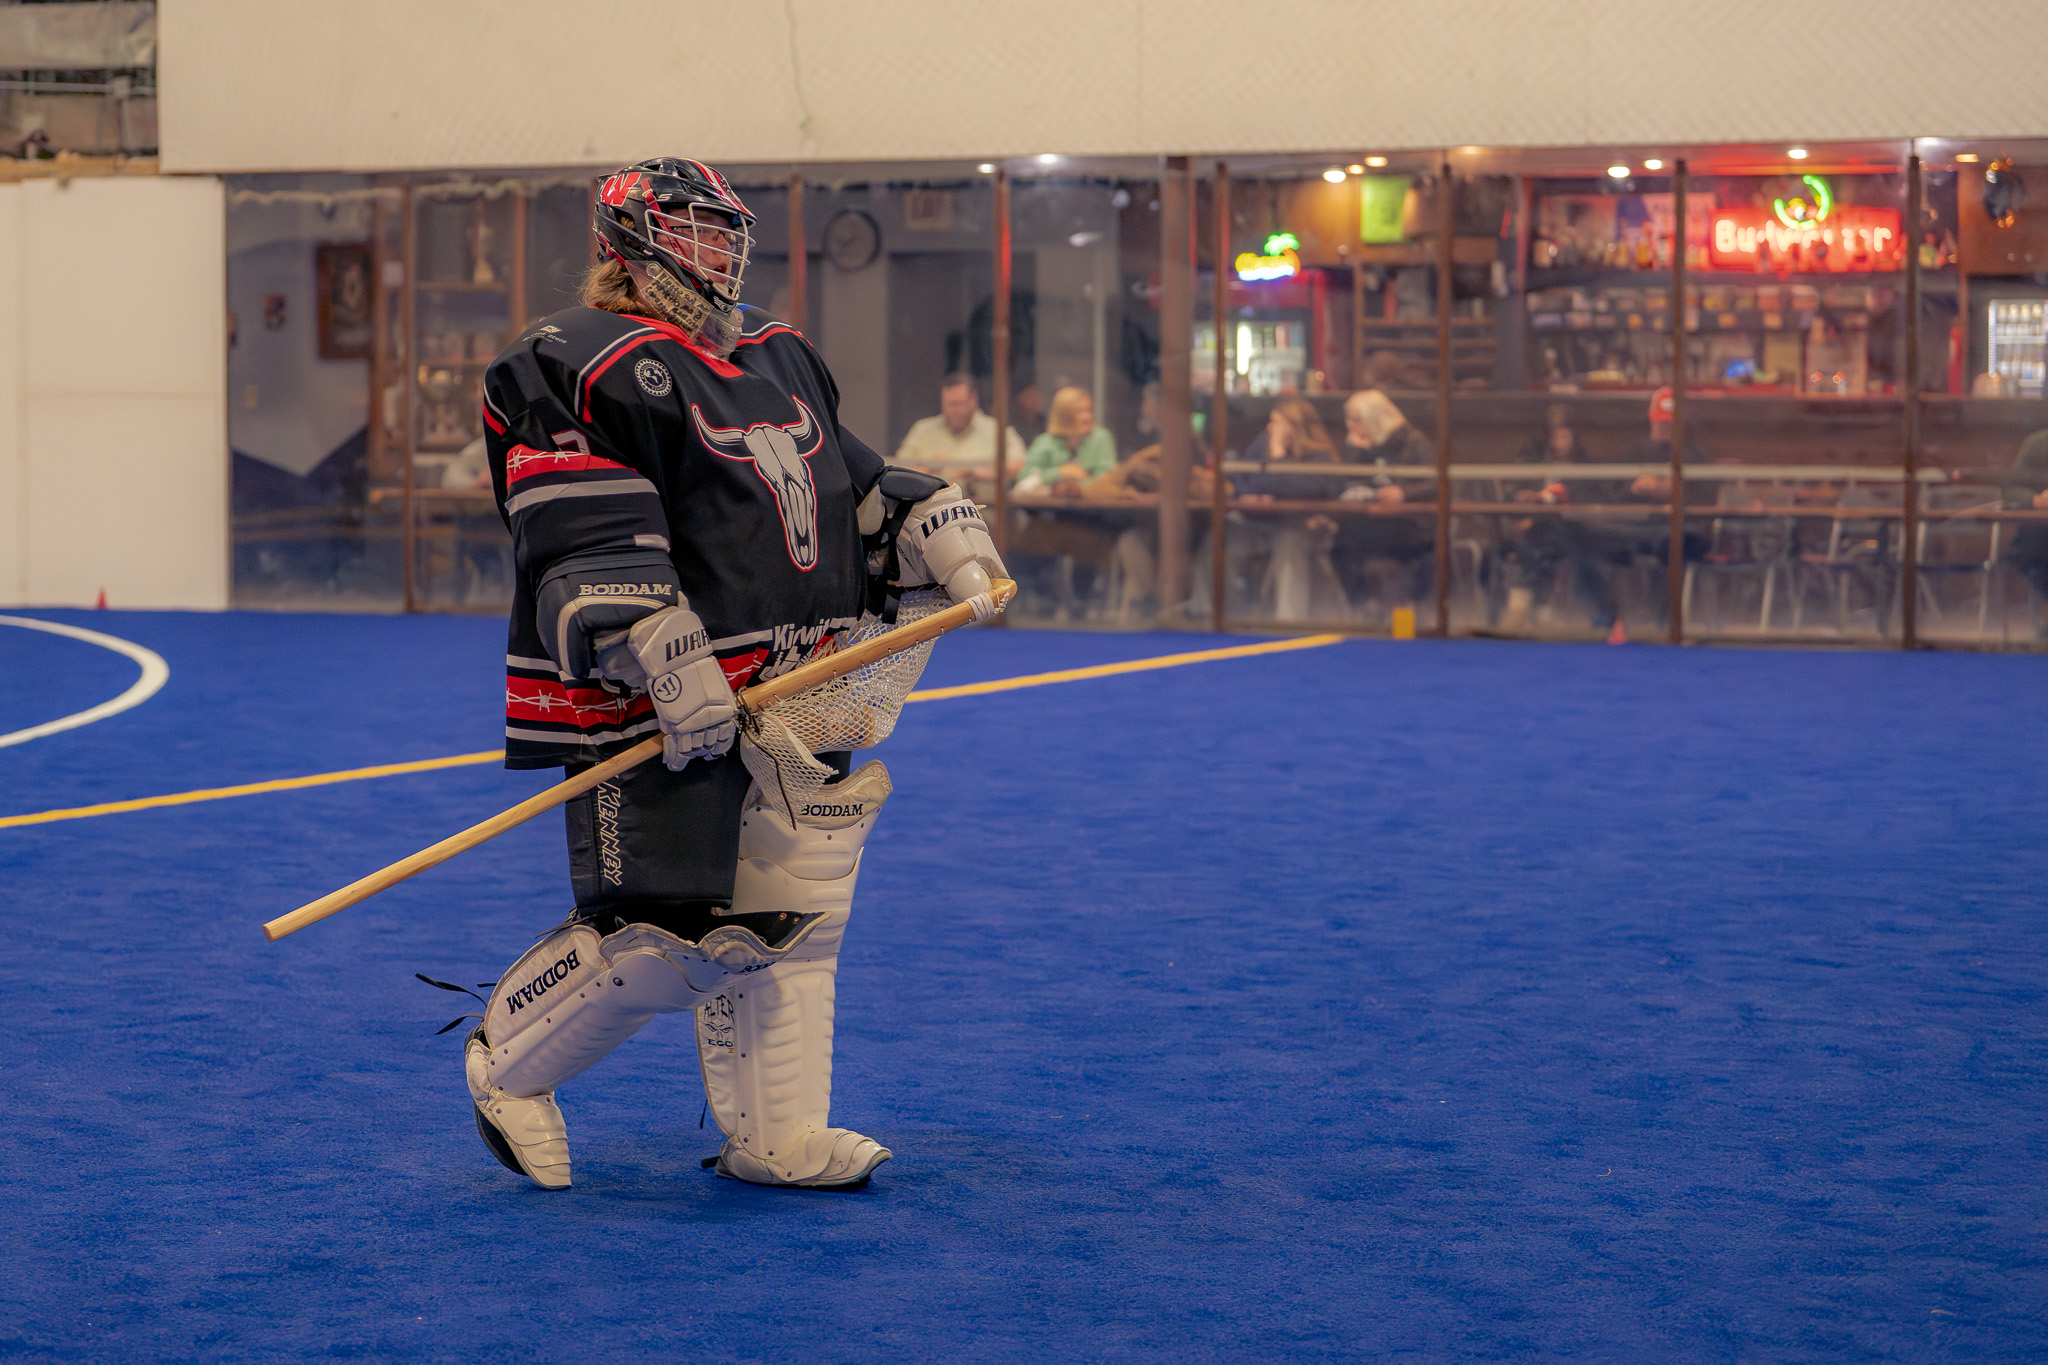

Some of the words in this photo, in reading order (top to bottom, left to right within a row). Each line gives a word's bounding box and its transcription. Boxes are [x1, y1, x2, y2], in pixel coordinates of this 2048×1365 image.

[579, 583, 672, 596] BODDAM
[799, 803, 864, 817] BODDAM
[597, 781, 623, 886] KENNEY
[505, 948, 581, 1016] BODDAM
[707, 1038, 734, 1048] EGO
